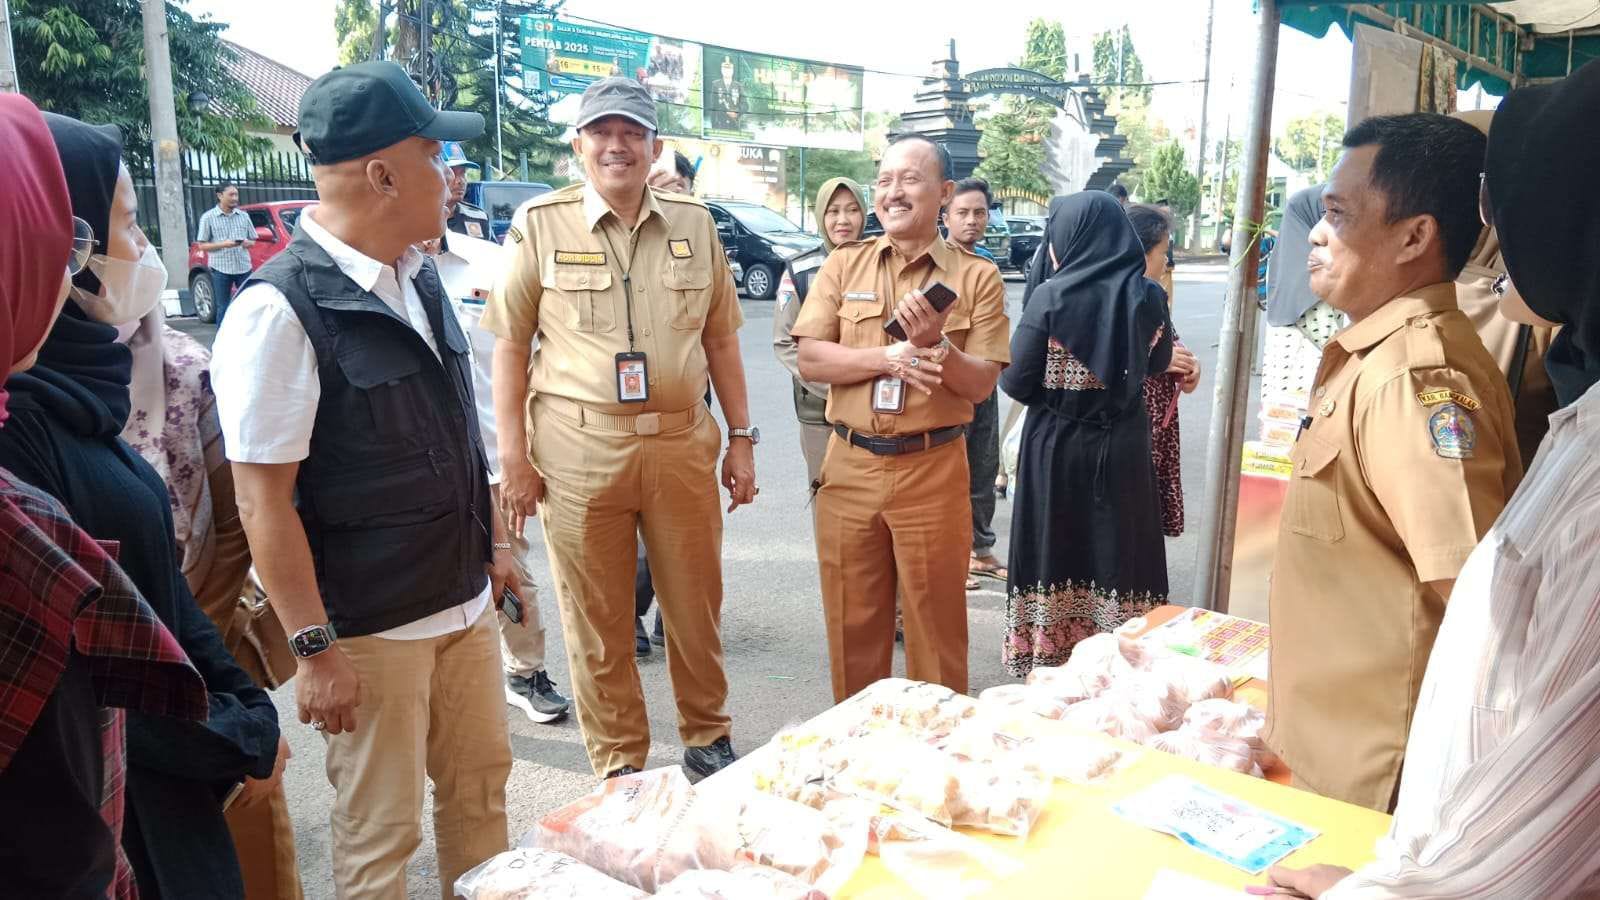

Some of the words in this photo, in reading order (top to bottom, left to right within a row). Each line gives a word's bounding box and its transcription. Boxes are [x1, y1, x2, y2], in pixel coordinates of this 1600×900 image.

[565, 41, 589, 53] 2025
[560, 60, 569, 69] 16
[592, 64, 601, 73] 15
